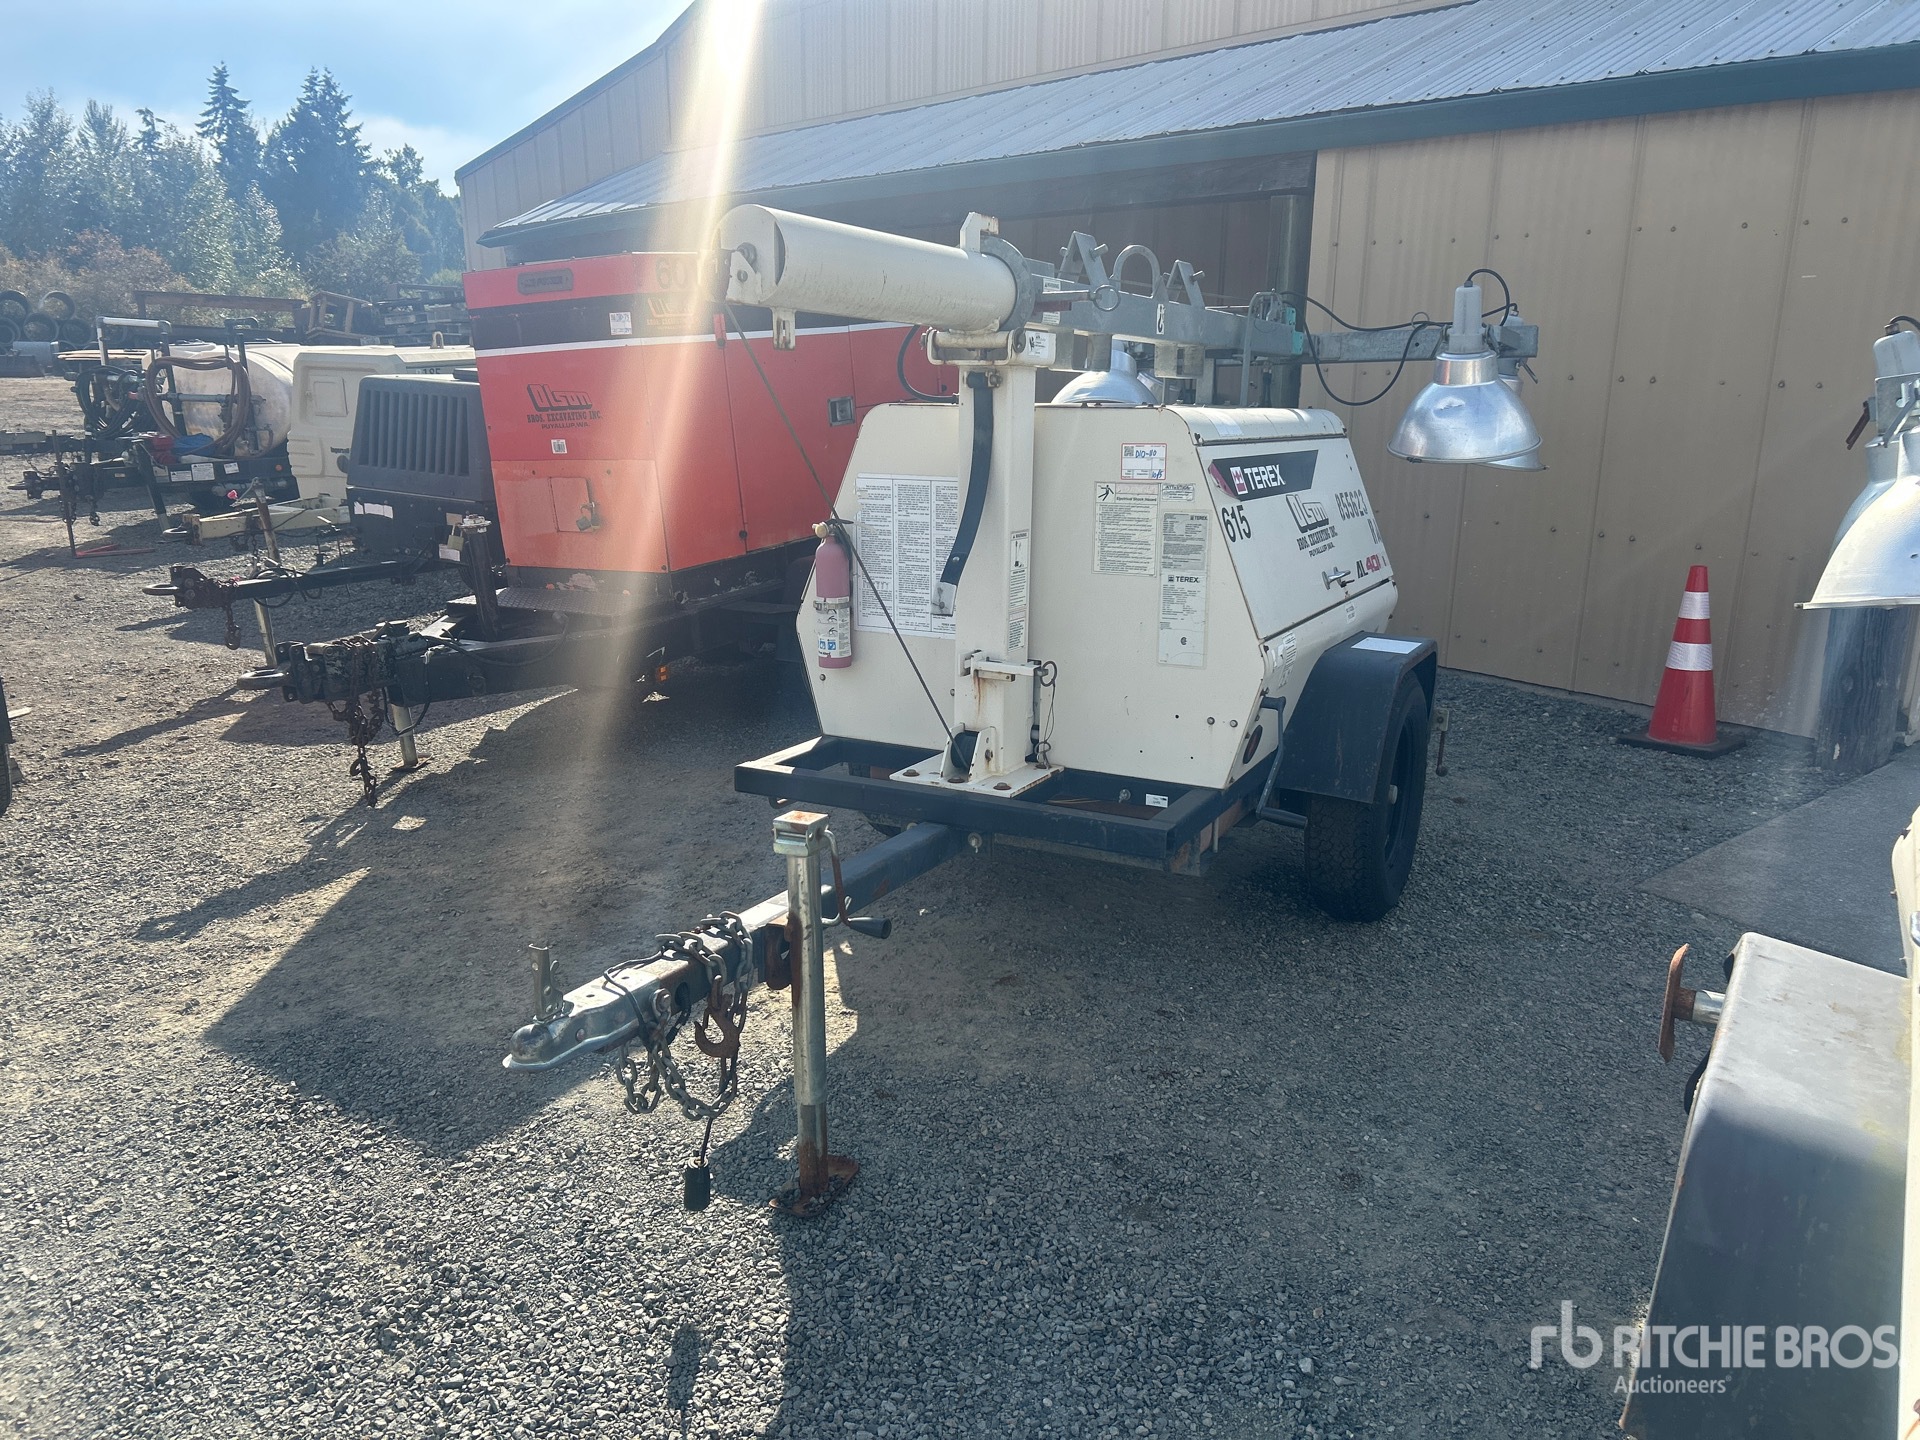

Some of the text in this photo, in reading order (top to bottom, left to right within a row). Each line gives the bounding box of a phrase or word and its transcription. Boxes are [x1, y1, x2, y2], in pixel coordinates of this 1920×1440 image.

[1243, 464, 1287, 491] TEREX
[1221, 504, 1252, 543] 615
[1175, 576, 1200, 584] TEREX
